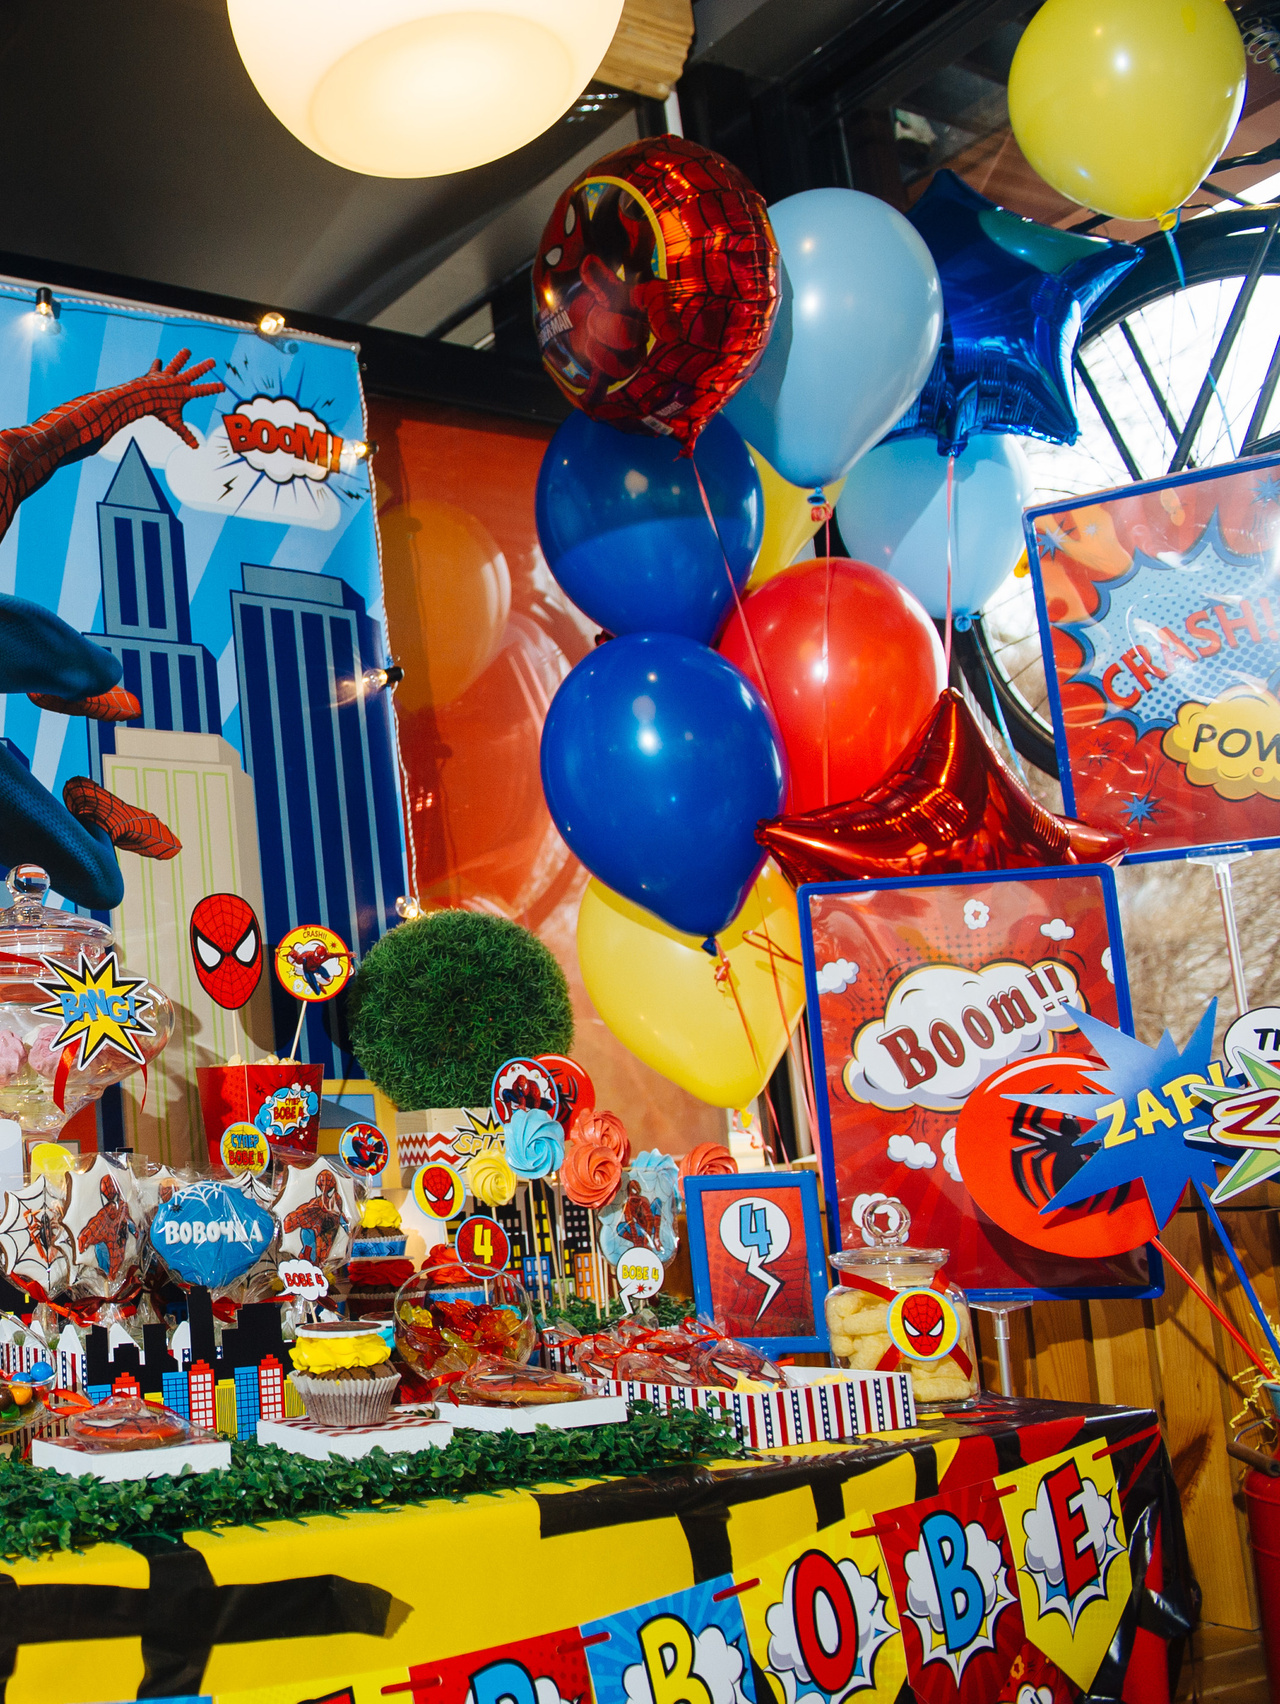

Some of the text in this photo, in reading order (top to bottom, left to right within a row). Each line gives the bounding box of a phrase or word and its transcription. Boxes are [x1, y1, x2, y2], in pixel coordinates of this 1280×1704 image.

[222, 413, 345, 474] BOOM!
[60, 989, 138, 1026] BANG!
[231, 1133, 260, 1149] СУПЕР
[228, 1150, 265, 1167] ВОВЕ 4
[165, 1219, 264, 1245] ВОВОЧКА
[739, 1202, 774, 1257] 4
[473, 1224, 494, 1265] 4
[284, 1272, 325, 1288] ВОВЕ 4
[622, 1264, 660, 1282] ВОВЕ 4
